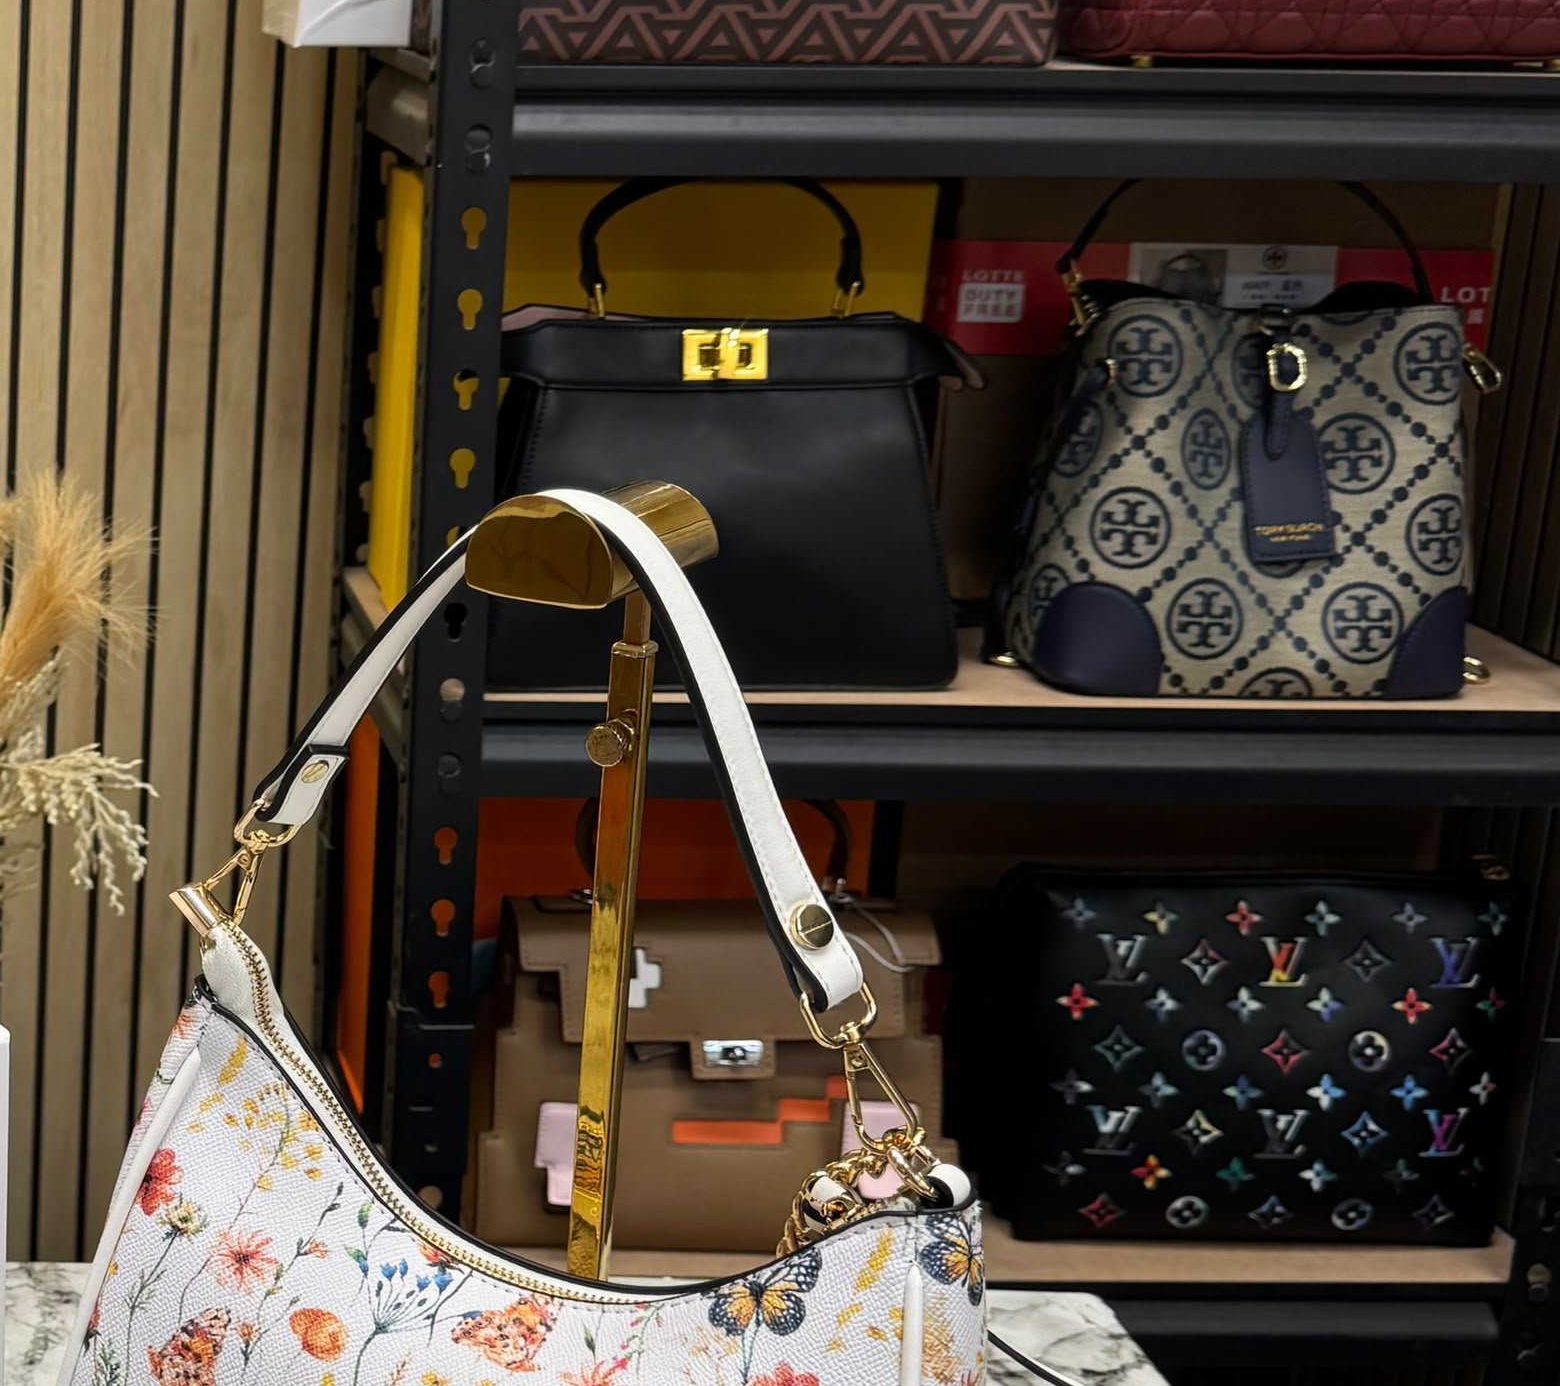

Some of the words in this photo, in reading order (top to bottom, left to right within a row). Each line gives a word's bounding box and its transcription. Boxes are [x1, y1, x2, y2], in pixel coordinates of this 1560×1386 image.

[961, 269, 1026, 282] LOTTE
[965, 287, 1018, 302] DUTY
[963, 303, 1017, 317] FREE
